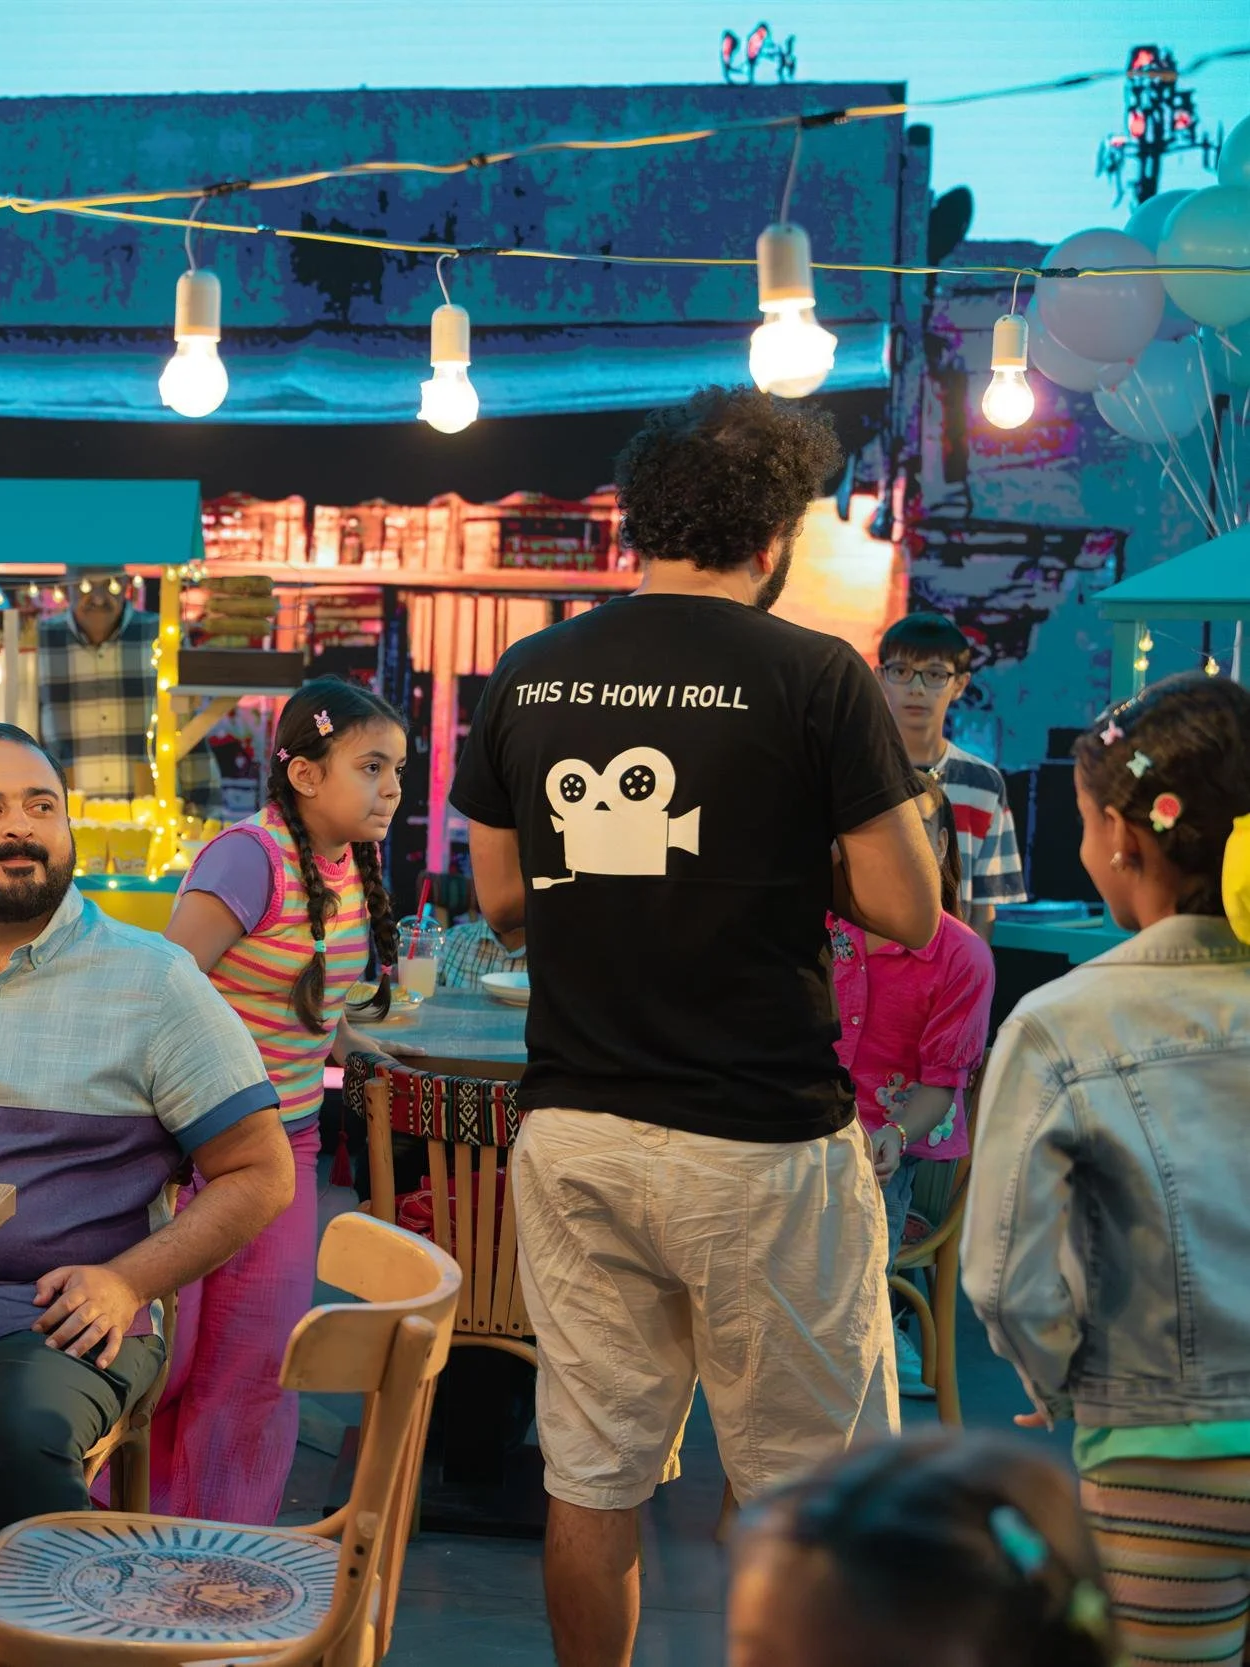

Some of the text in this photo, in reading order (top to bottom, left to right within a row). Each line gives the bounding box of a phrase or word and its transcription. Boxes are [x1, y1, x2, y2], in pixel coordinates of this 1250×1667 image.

[516, 681, 749, 710] THIS IS HOW I ROLL
